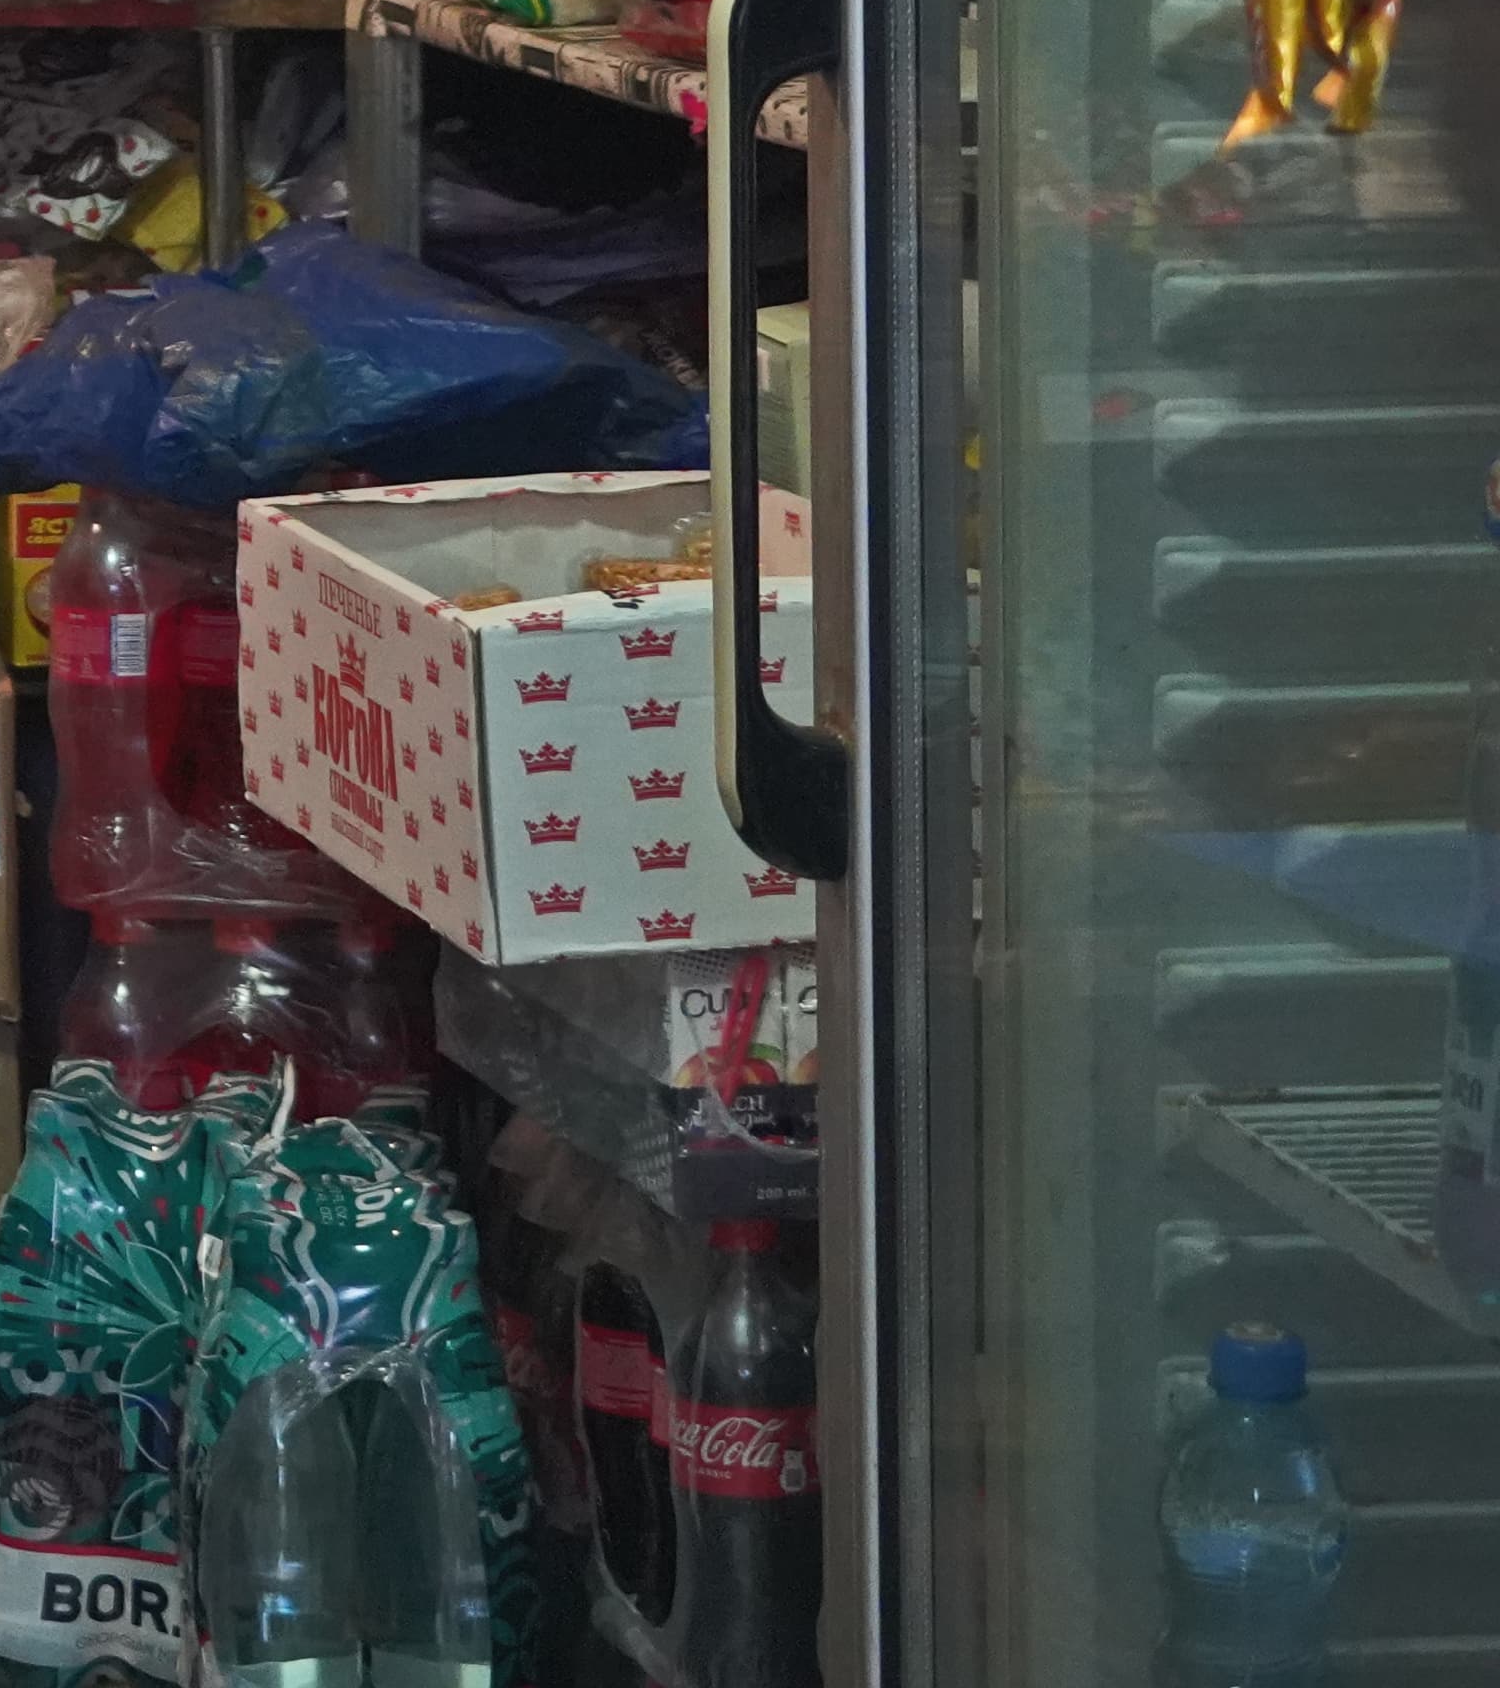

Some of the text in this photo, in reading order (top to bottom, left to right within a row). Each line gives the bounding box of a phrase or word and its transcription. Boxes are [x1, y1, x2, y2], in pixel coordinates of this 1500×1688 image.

[319, 571, 384, 641] ПЕЧЕНЬЕ
[313, 664, 400, 804] КОРОНА
[672, 1415, 790, 1470] ca-Cola
